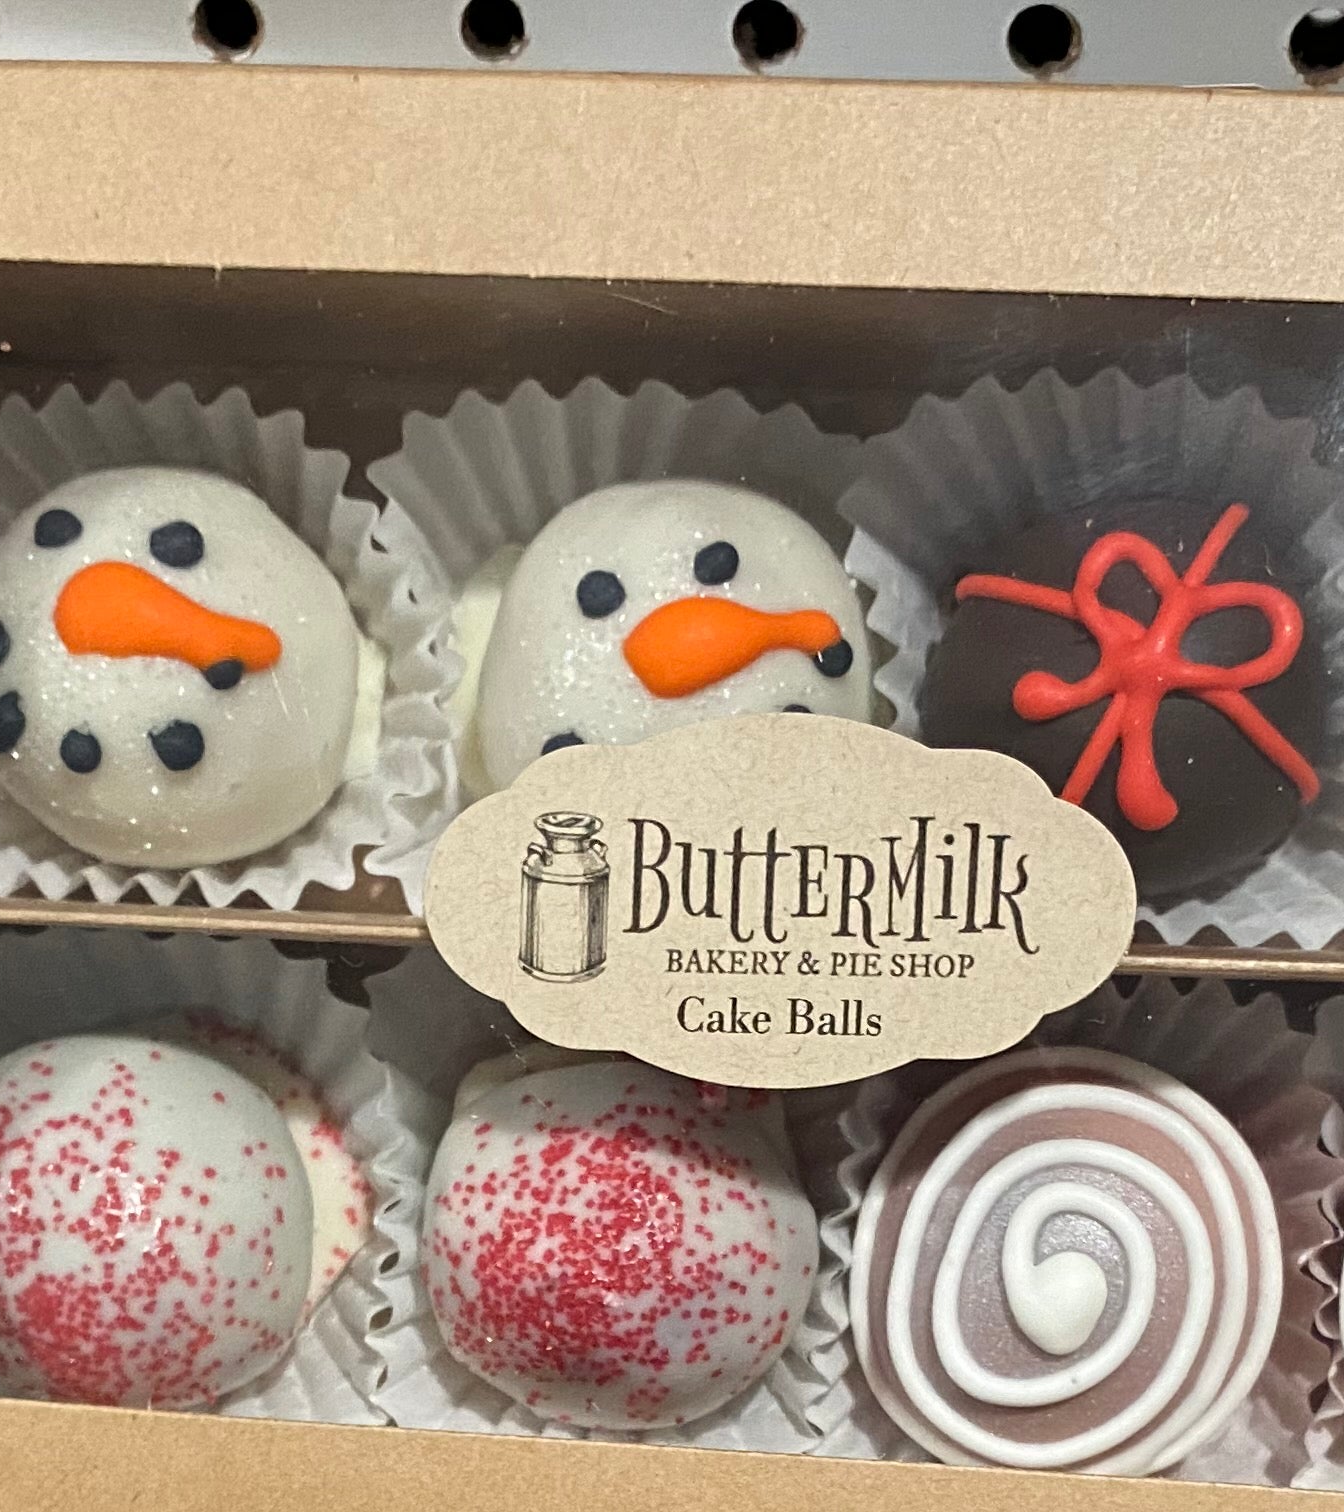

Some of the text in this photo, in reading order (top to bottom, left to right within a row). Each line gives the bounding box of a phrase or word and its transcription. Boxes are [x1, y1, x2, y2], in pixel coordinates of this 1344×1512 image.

[664, 948, 975, 979] BAKERY & PIE SHOP
[676, 995, 882, 1037] Cake Balls
